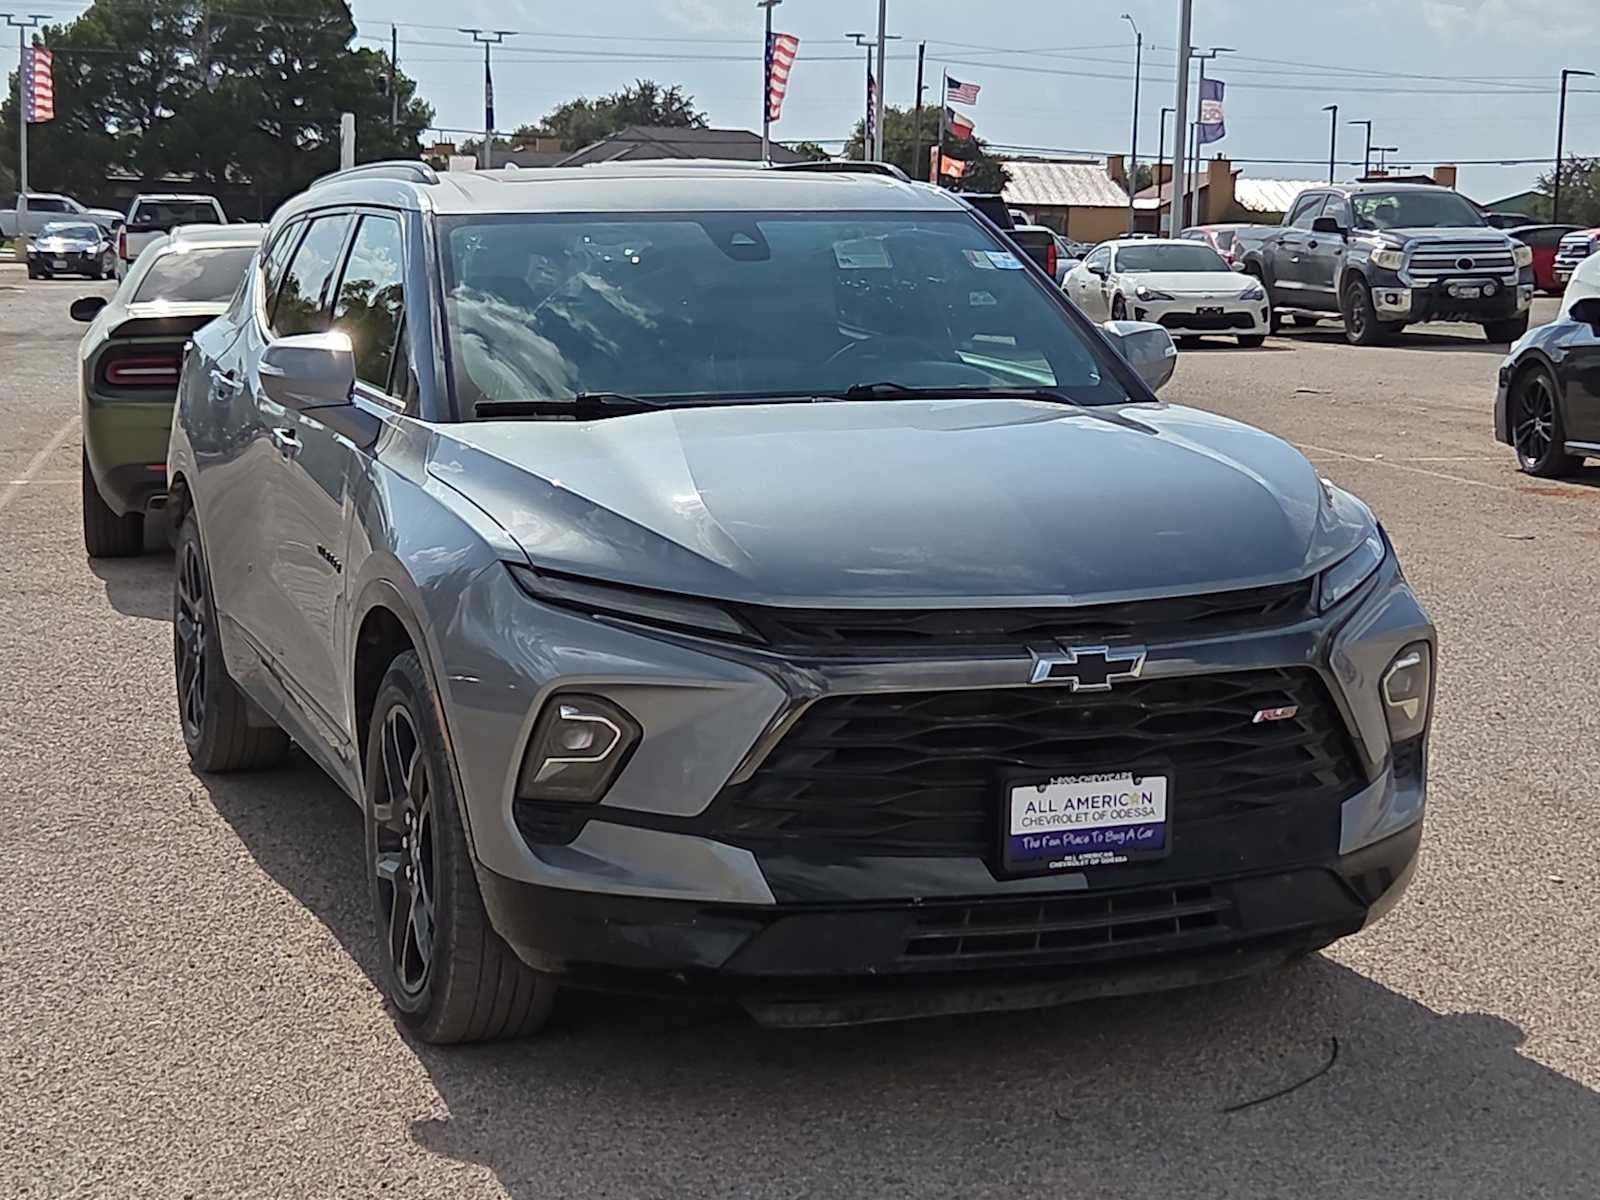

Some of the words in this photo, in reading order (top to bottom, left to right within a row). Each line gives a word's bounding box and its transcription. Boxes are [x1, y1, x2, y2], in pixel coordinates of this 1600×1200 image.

[1022, 812, 1088, 827] CHEVROLET
[1092, 810, 1107, 821] OF
[1111, 807, 1155, 819] ODESSA
[1025, 800, 1057, 815] ALL
[1022, 836, 1040, 850] The
[1063, 832, 1089, 848] Place
[1091, 831, 1103, 843] To
[1105, 830, 1125, 845] Buy
[1126, 828, 1135, 841] A
[1137, 827, 1154, 840] Car
